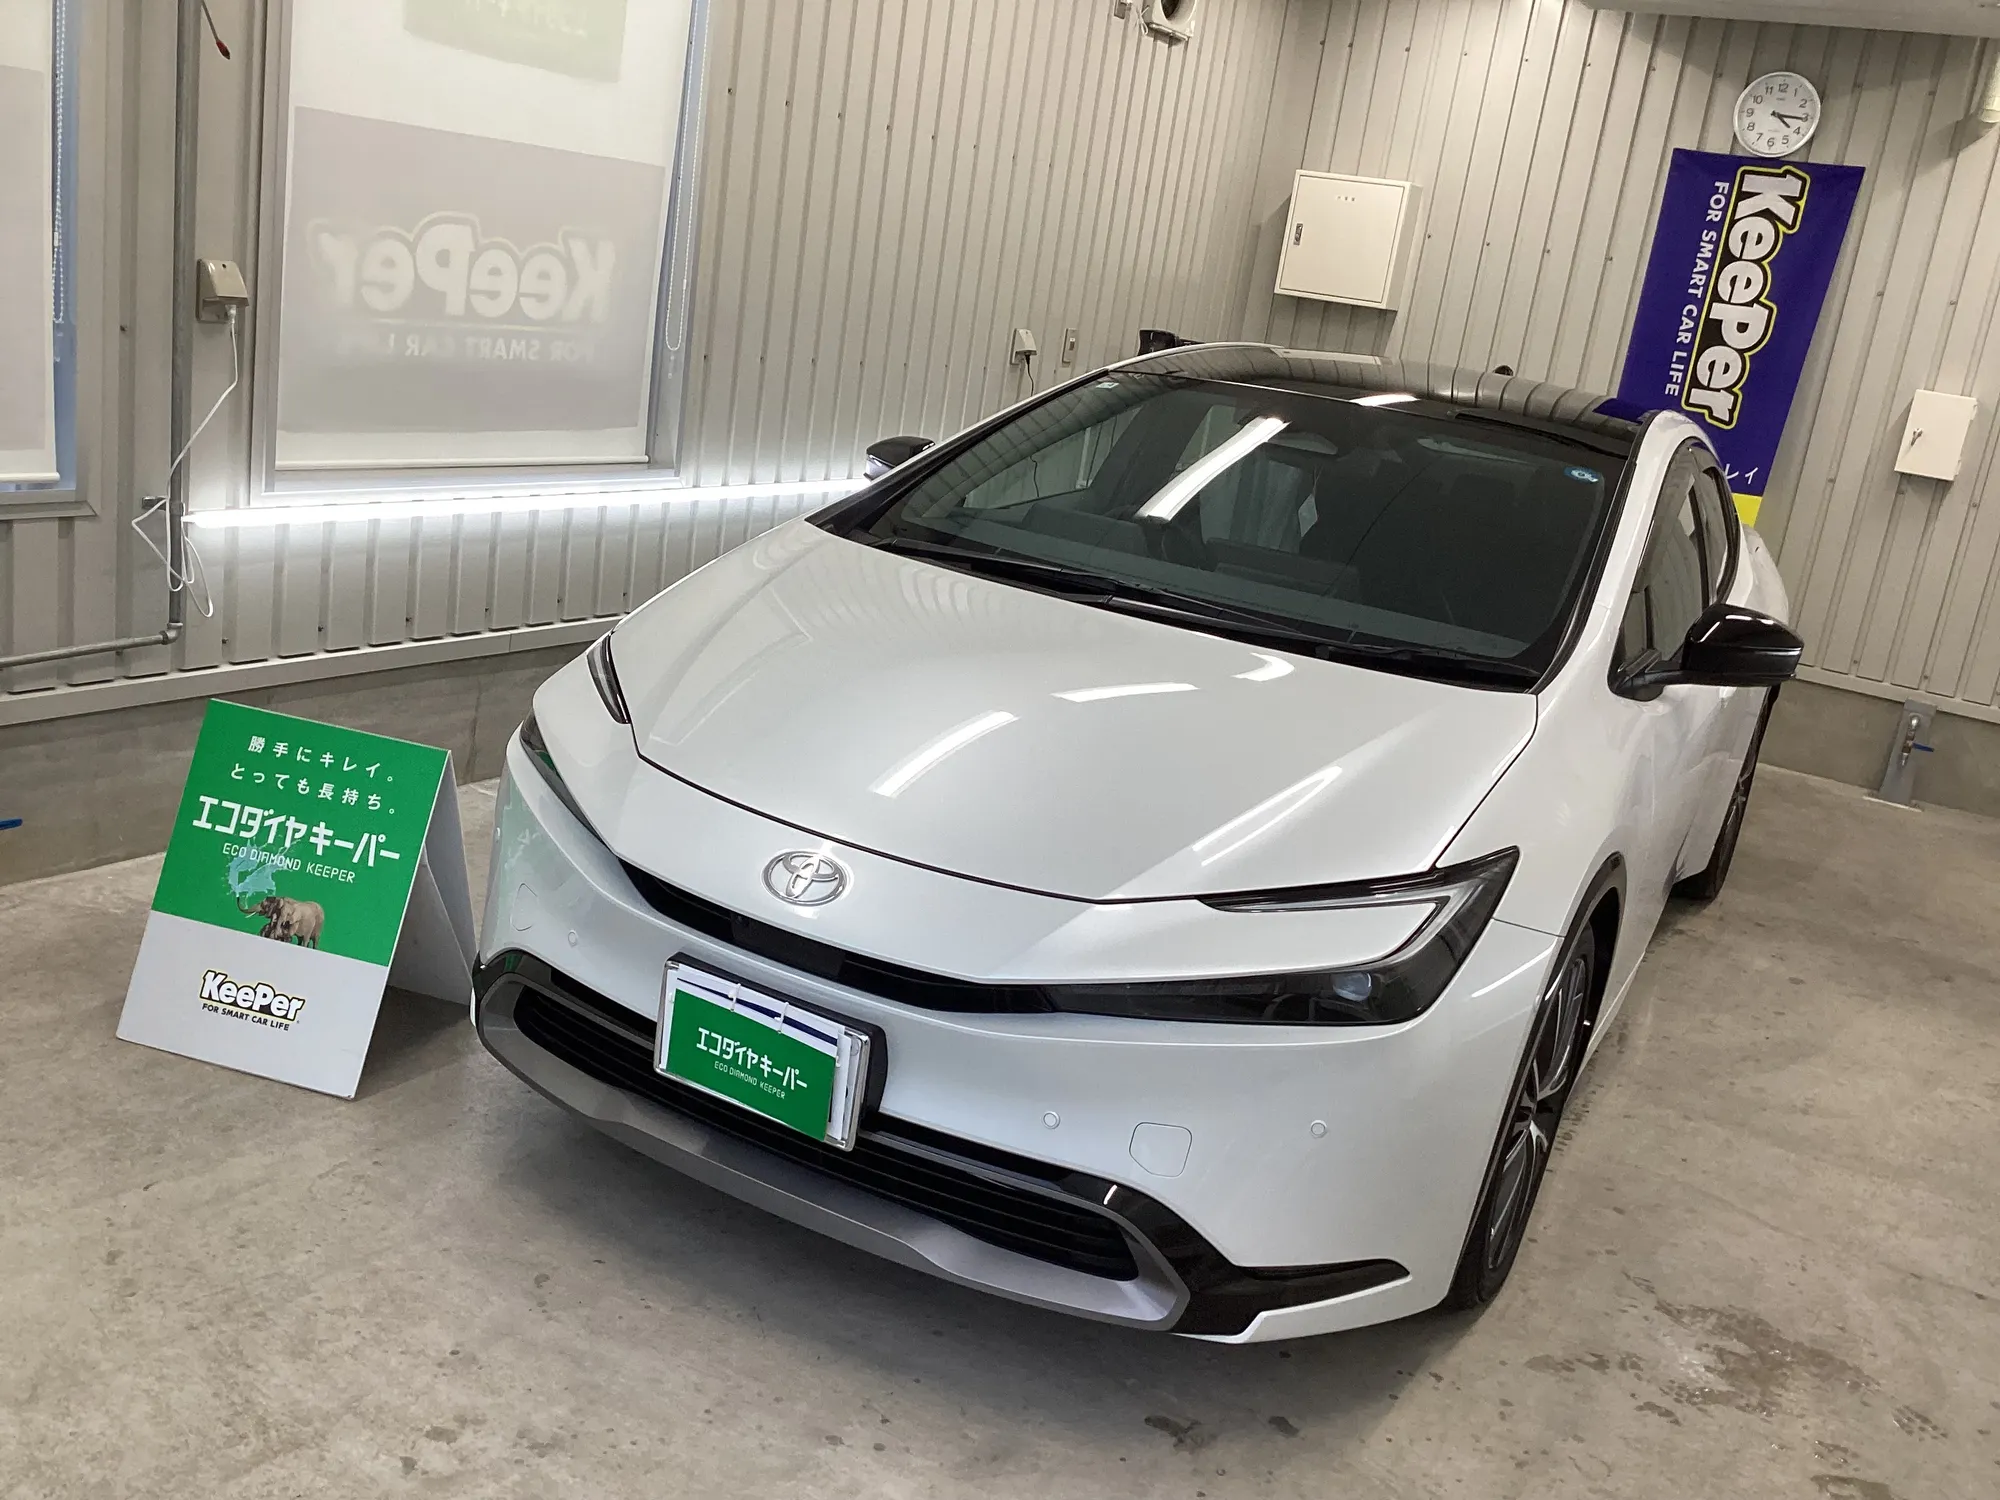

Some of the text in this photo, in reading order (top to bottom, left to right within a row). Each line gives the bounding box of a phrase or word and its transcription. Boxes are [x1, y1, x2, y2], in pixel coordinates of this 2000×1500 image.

[1765, 86, 1774, 95] 11
[1778, 83, 1789, 92] 12
[1752, 95, 1763, 104] 10
[1799, 99, 1808, 108] 2
[1746, 108, 1754, 117] 9
[1801, 113, 1809, 122] 3
[1746, 122, 1755, 131] 8
[1793, 126, 1801, 135] 4
[1756, 133, 1764, 141] 7
[1767, 137, 1775, 147] 6
[1781, 135, 1789, 145] 5
[1665, 181, 1730, 397] FOR SMART CAR LIFE
[1686, 171, 1805, 424] KeePer
[248, 735, 393, 782] 勝手にキレイ。
[230, 763, 395, 815] とっても長持ち。
[192, 795, 400, 867] エコダイヤキーパー
[222, 842, 356, 884] ECO DIAMOND KEEPER
[200, 969, 305, 1021] KeePer
[202, 1003, 290, 1031] FOR SMART CAR LIFE
[696, 1027, 808, 1090] エコダイヤキーパー
[714, 1060, 786, 1100] ECO DIAMOND KEEPER
